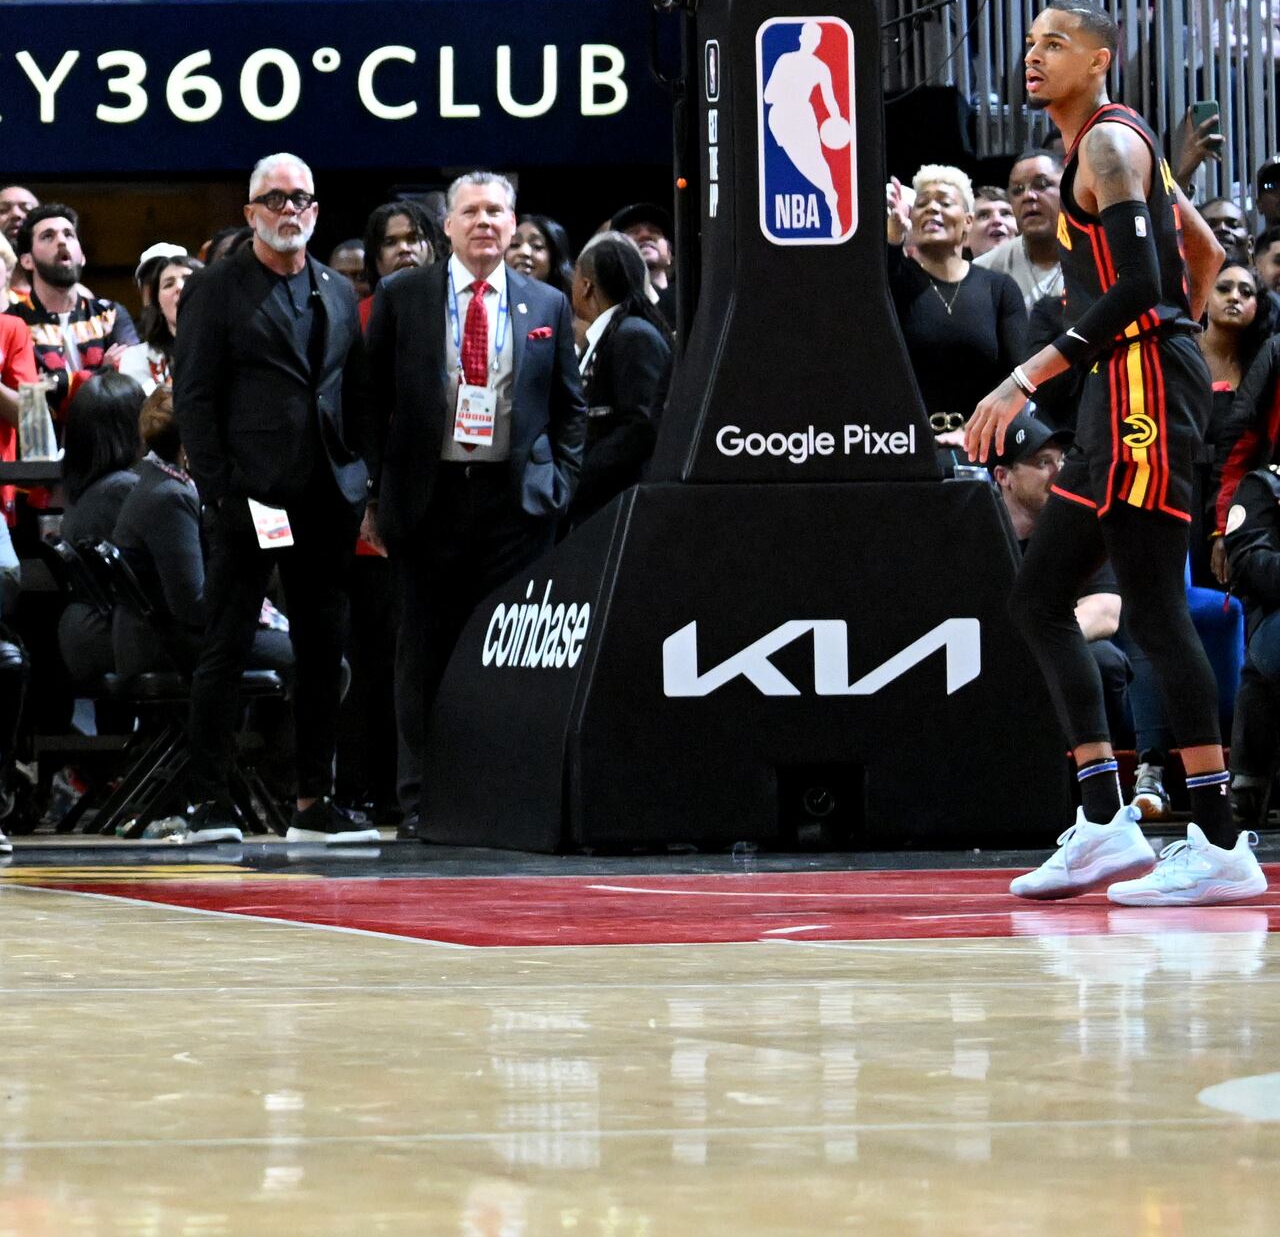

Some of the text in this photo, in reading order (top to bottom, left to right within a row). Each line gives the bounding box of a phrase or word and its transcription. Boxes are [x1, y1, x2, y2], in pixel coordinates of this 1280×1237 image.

[774, 194, 821, 231] NBA
[715, 423, 916, 464] Google Pixel
[482, 579, 591, 669] coinbase
[662, 616, 982, 698] KIA
